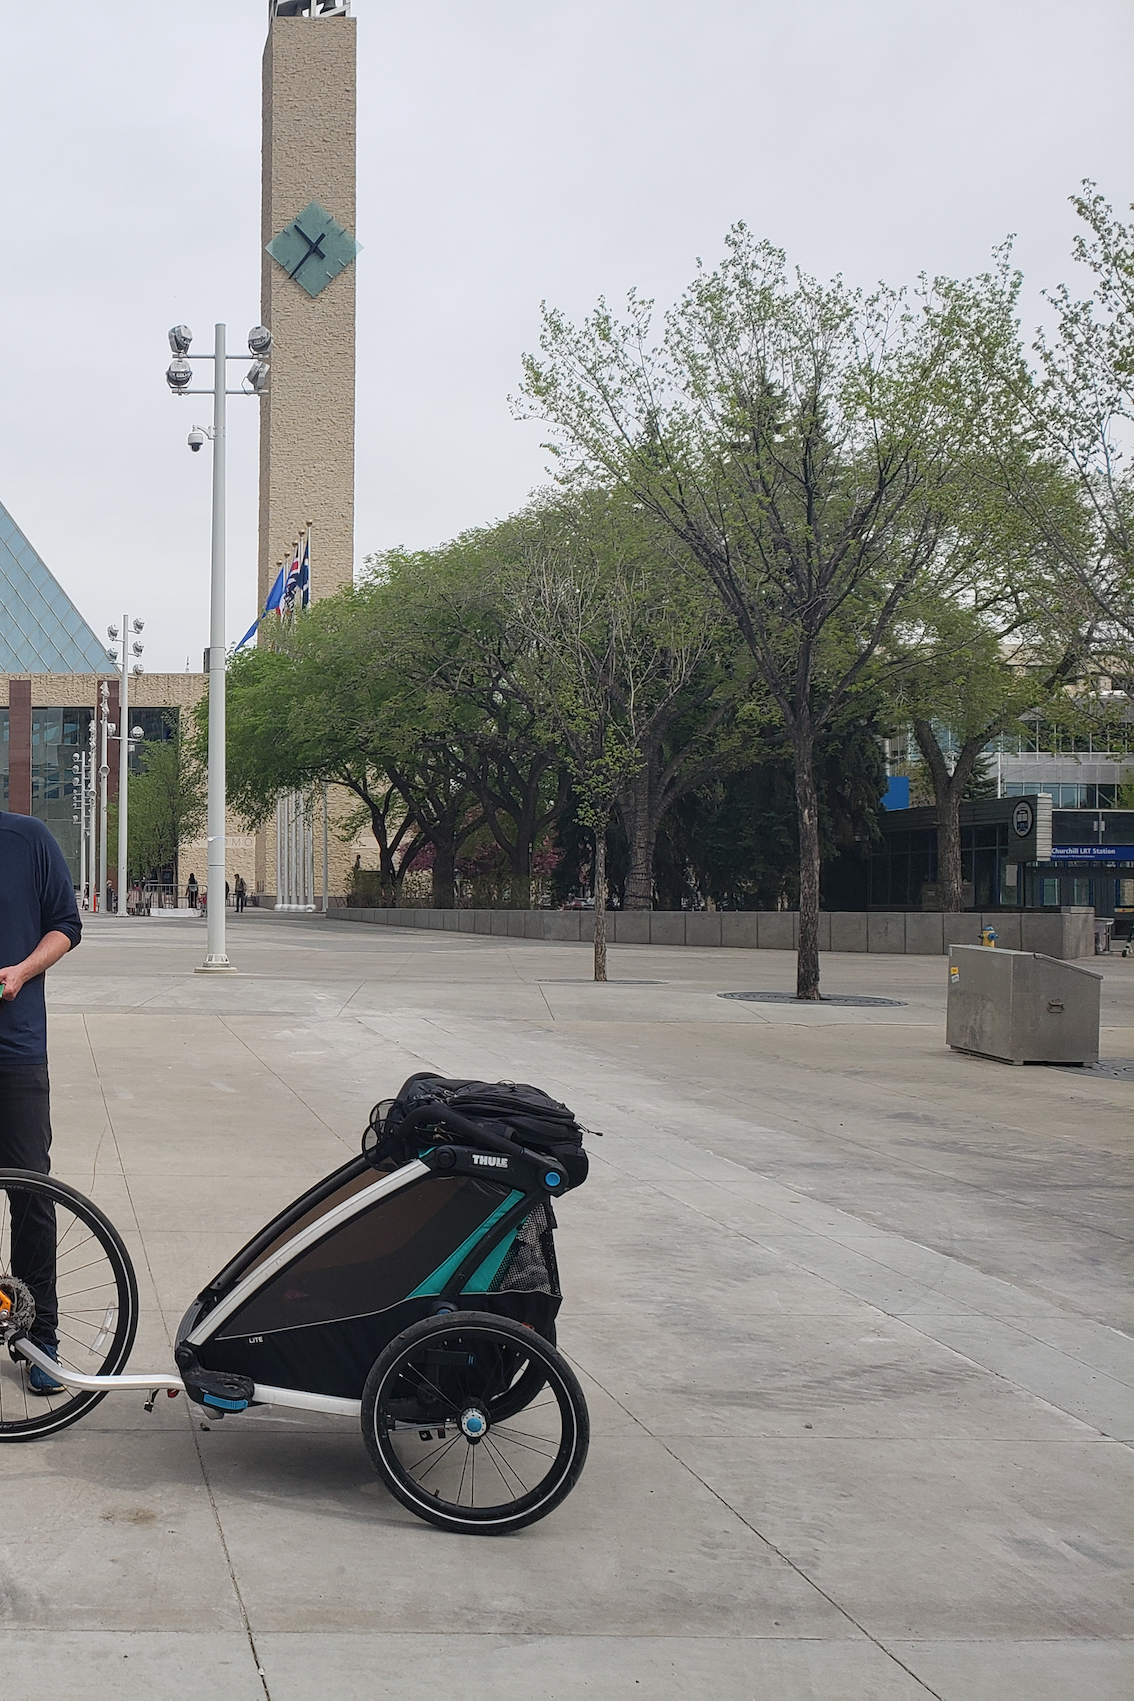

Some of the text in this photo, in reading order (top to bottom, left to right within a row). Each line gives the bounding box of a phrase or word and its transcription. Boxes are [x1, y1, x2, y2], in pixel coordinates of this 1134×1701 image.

[1052, 847, 1116, 855] Churchill LRT Station
[472, 1154, 509, 1168] THULE
